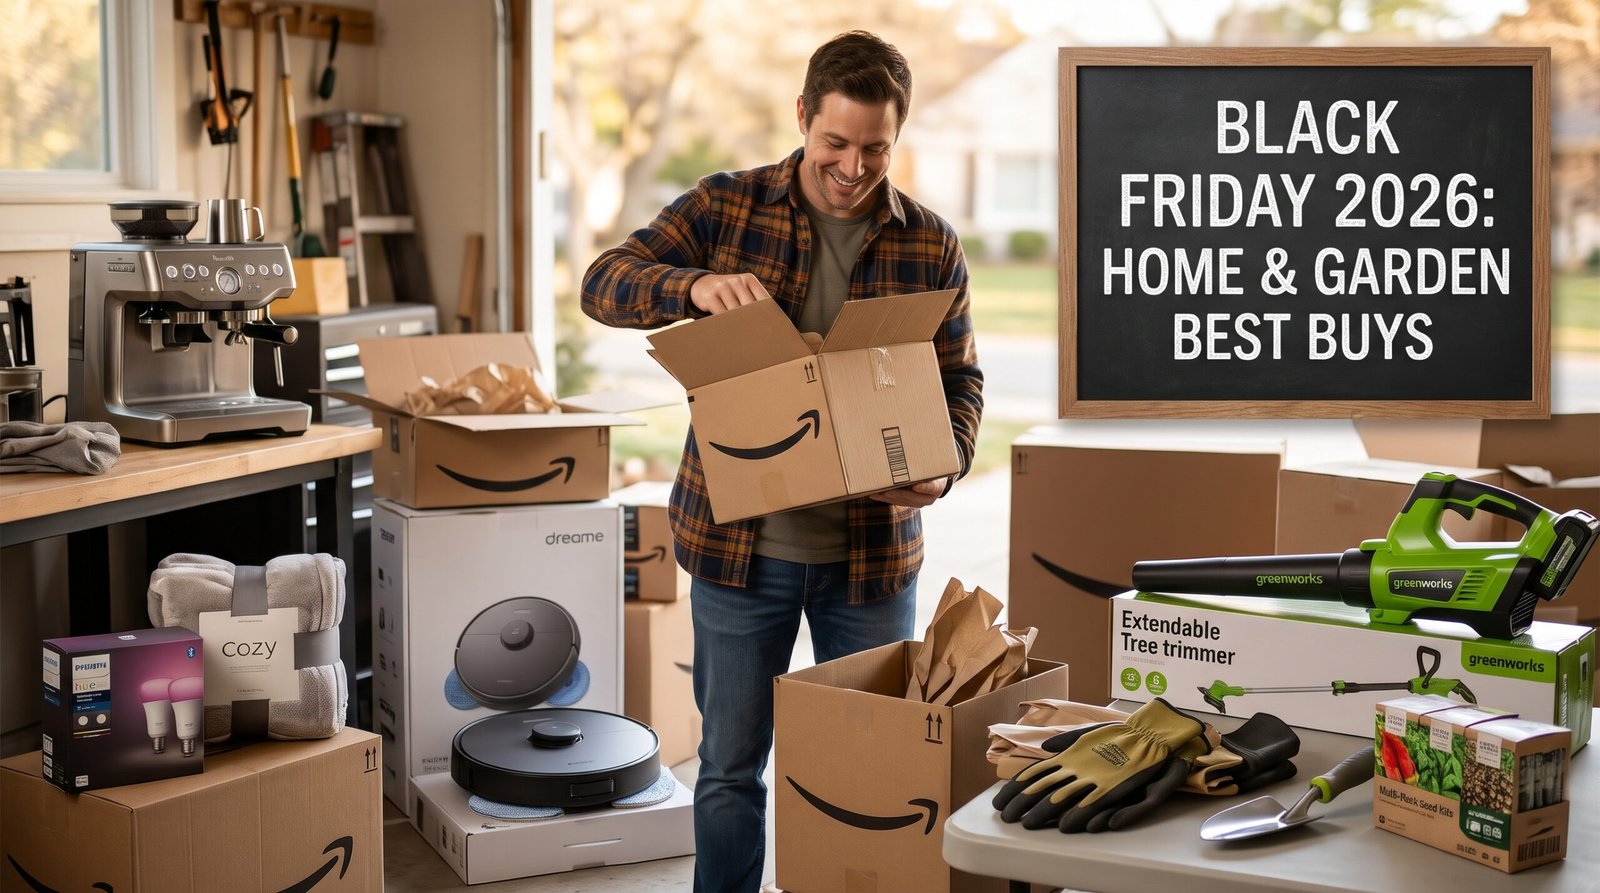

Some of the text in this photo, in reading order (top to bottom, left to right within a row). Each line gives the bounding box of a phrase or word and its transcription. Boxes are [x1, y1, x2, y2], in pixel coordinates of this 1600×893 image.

[1217, 100, 1400, 154] BLACK
[1121, 173, 1494, 228] FRIDAY 2026:
[1103, 247, 1510, 295] HOME & GARDEN
[1174, 313, 1433, 360] BEST BUYS
[545, 532, 604, 545] dreame
[1256, 572, 1323, 586] greenworks
[1393, 578, 1453, 590] greenworks
[1122, 610, 1220, 640] Extendable
[1121, 632, 1158, 654] Tree
[1163, 640, 1235, 665] trimmer
[1469, 654, 1545, 673] greenworks
[1419, 800, 1438, 813] Seed
[1440, 804, 1454, 818] Kits
